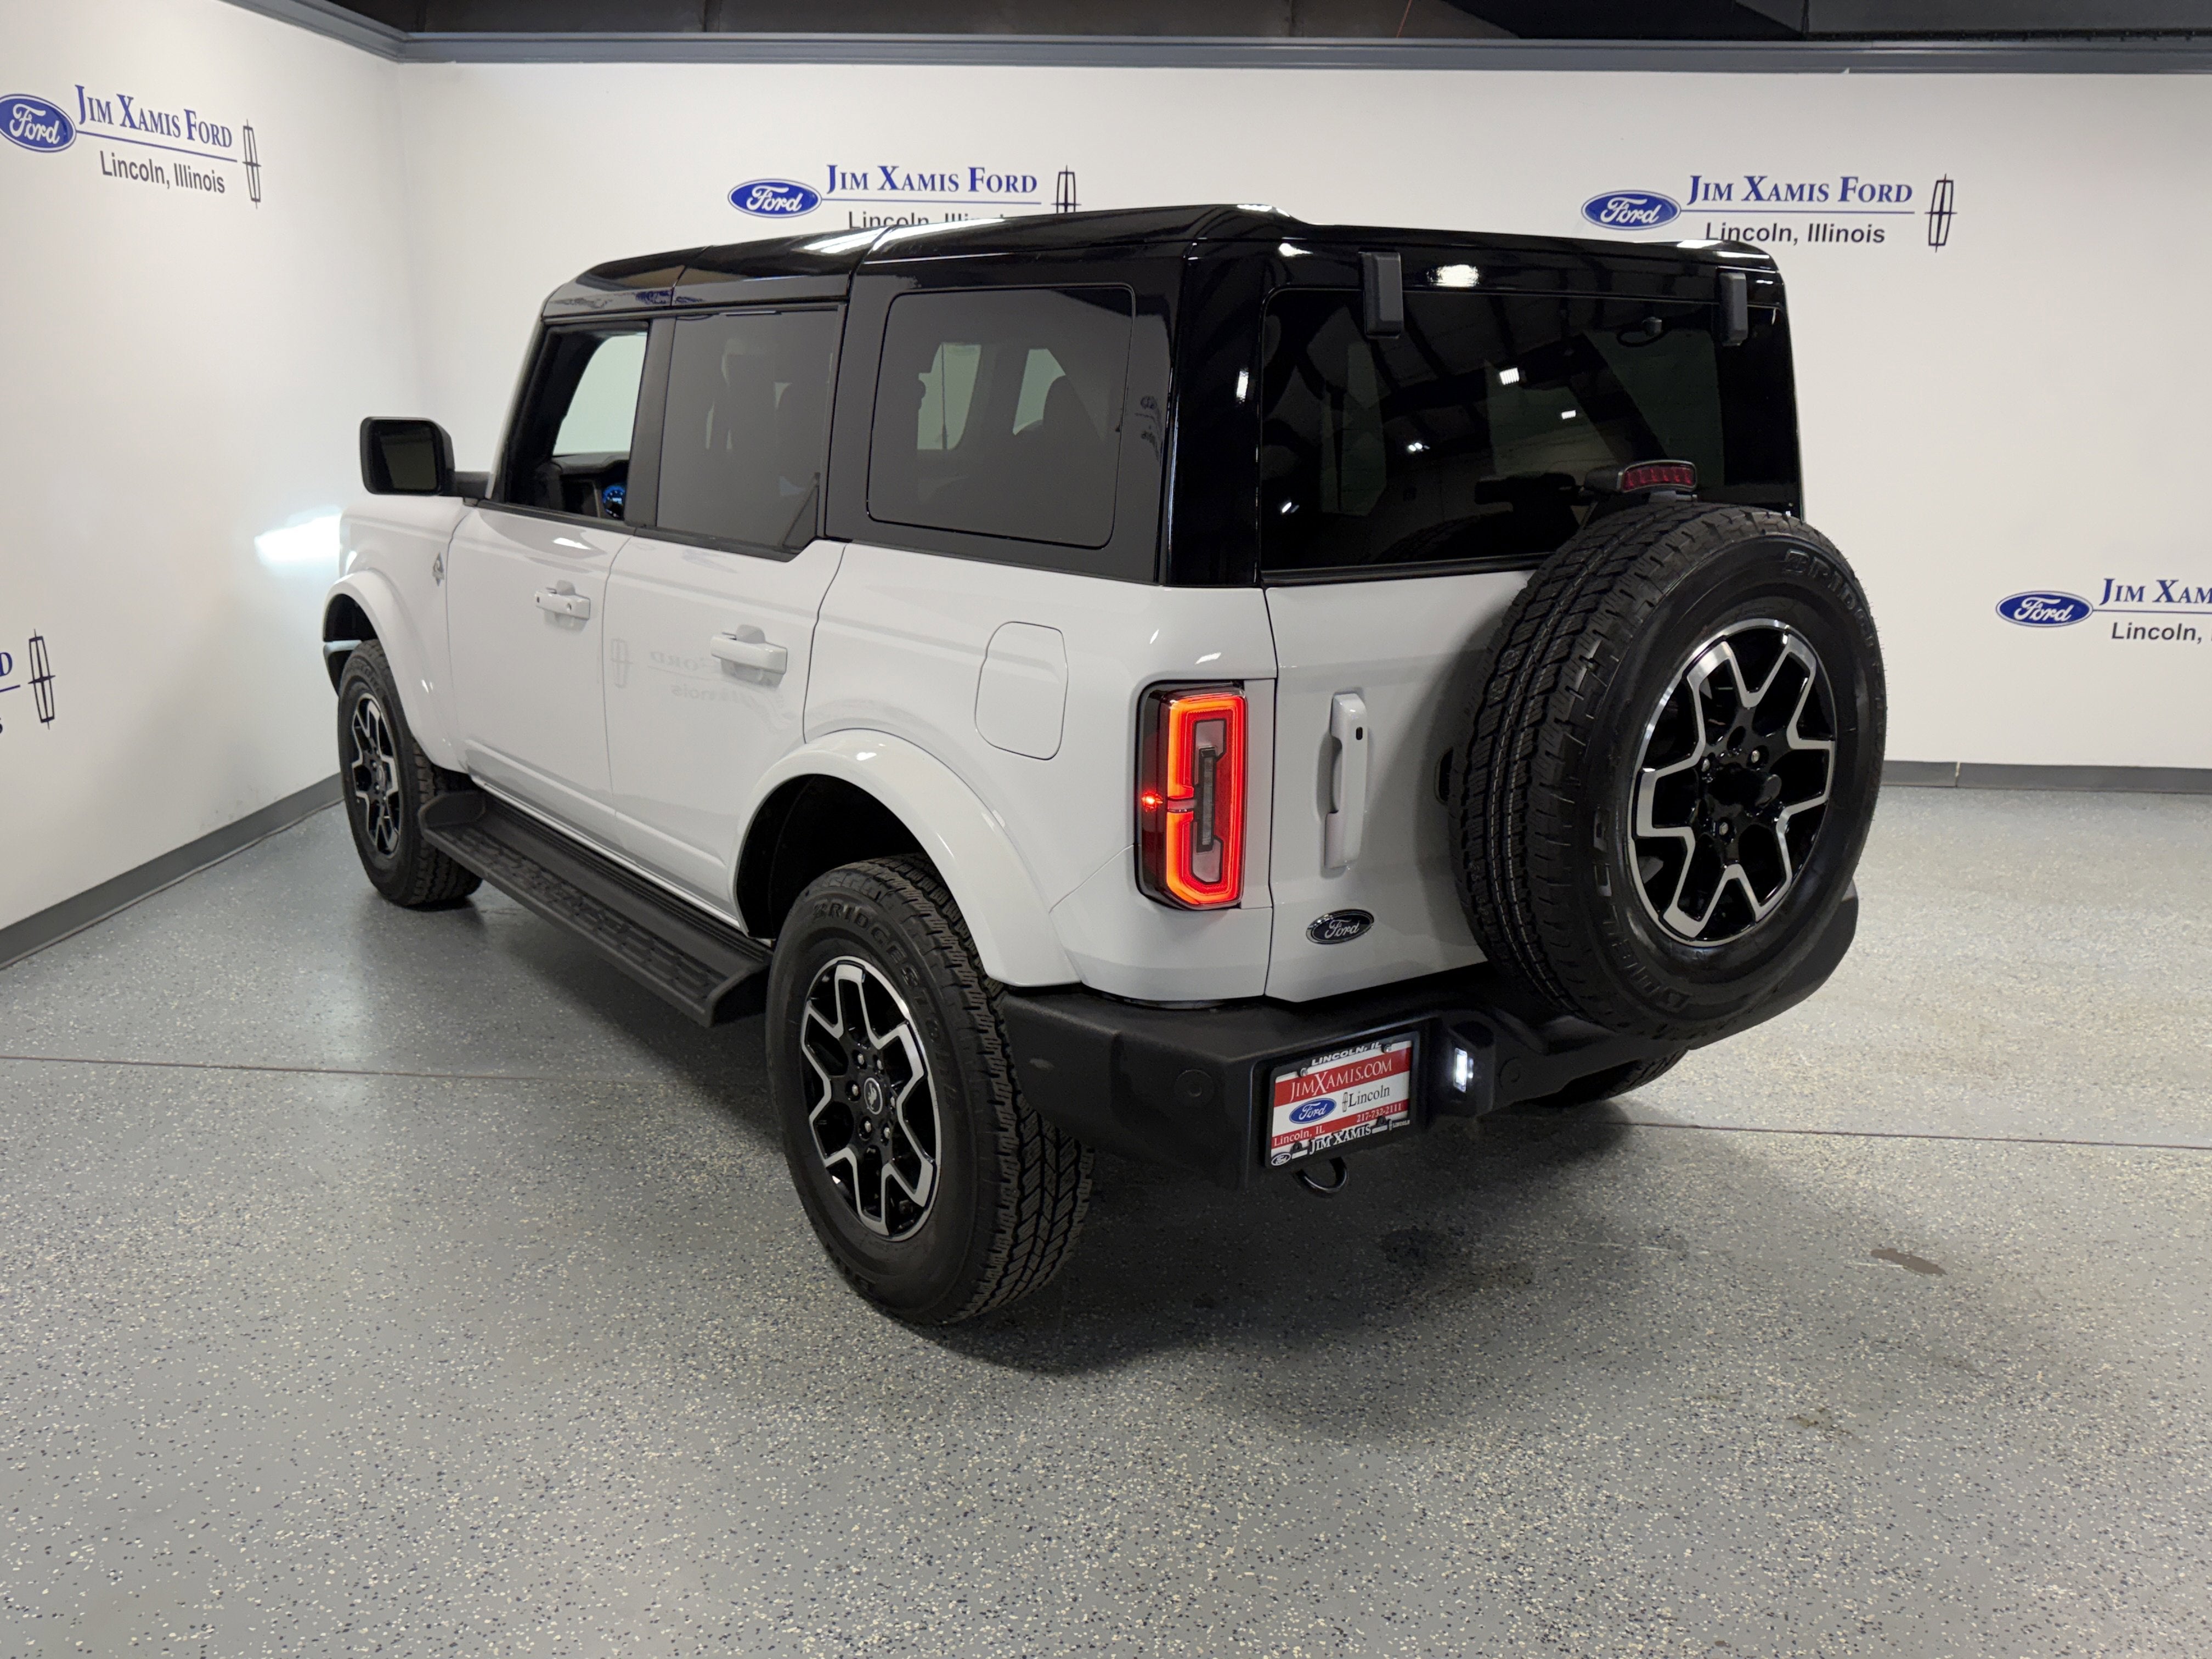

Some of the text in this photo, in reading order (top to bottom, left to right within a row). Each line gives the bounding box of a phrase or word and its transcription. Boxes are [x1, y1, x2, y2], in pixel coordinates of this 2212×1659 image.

[9, 103, 60, 144] Ford
[75, 84, 233, 148] JIM XAMIS FORD
[100, 150, 225, 193] Lincoln, Illinois
[827, 165, 1037, 194] JIM XAMIS FORD
[746, 186, 804, 212] Ford
[1687, 175, 1914, 206] JIM XAMIS FORD
[1600, 196, 1662, 224] Ford
[1705, 222, 1886, 246] Lincoln, Illinois
[2099, 578, 2146, 606] JIM
[2013, 596, 2075, 622] Ford
[2112, 622, 2202, 644] Lincoln,
[1324, 919, 1361, 939] Ford
[1290, 1058, 1392, 1102] JIMXAMIS.COM
[1348, 1085, 1390, 1107] Lincoln
[1299, 1102, 1327, 1120] Ford
[1356, 1102, 1402, 1123] 217-732-2111
[1274, 1125, 1325, 1147] Lincoln, IL
[1310, 1136, 1331, 1155] JIM
[1334, 1124, 1372, 1143] XAMIS
